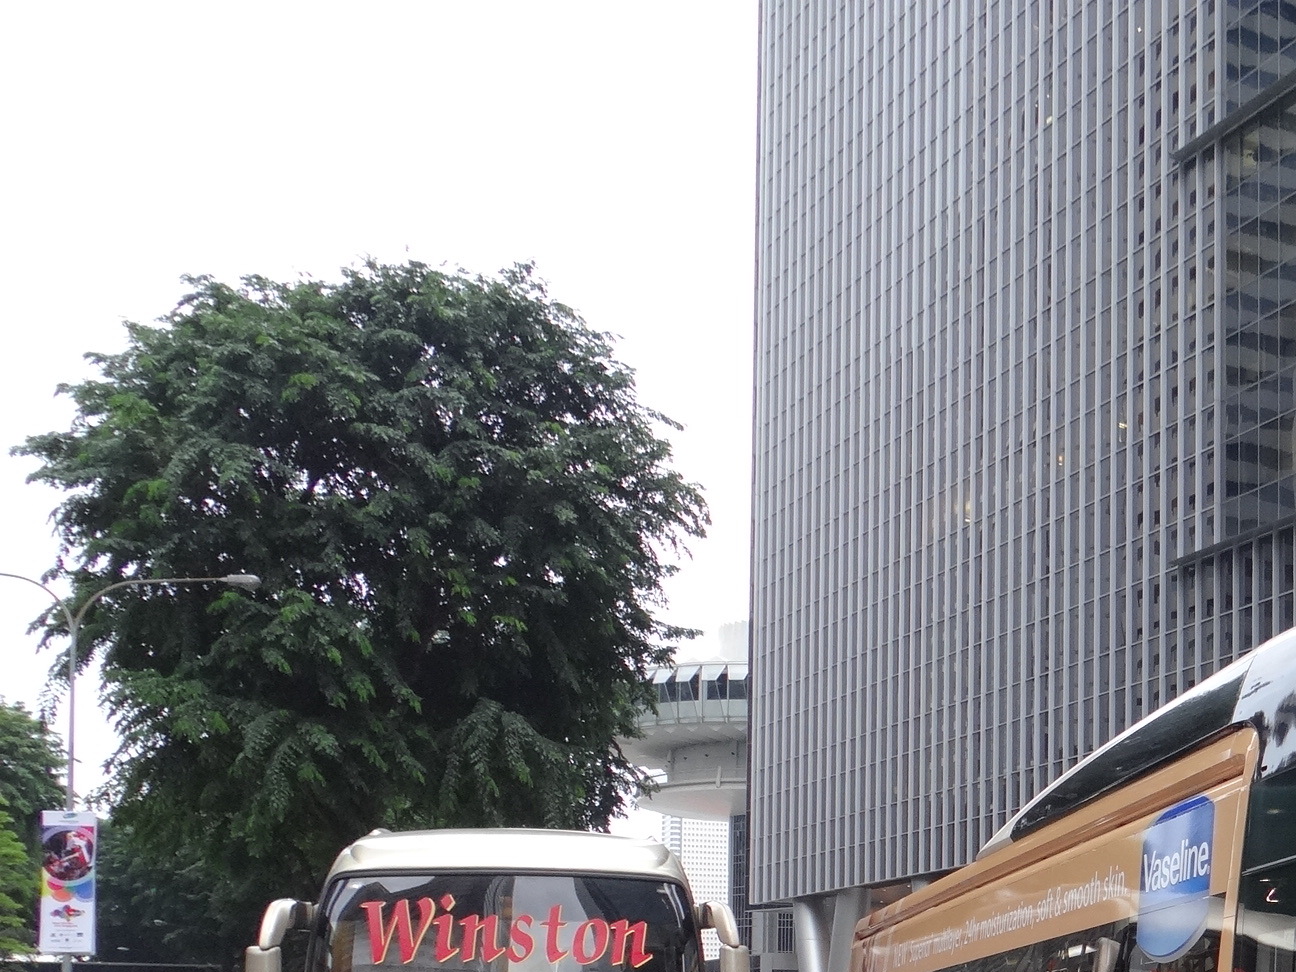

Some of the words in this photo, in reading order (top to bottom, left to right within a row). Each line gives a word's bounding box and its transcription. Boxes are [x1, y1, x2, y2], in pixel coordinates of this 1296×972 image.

[1036, 888, 1053, 923] soft
[1054, 886, 1062, 917] &
[1063, 871, 1101, 914] smooth
[1103, 865, 1128, 901] skin.
[1143, 838, 1209, 893] Vaseline
[359, 893, 654, 968] Winston
